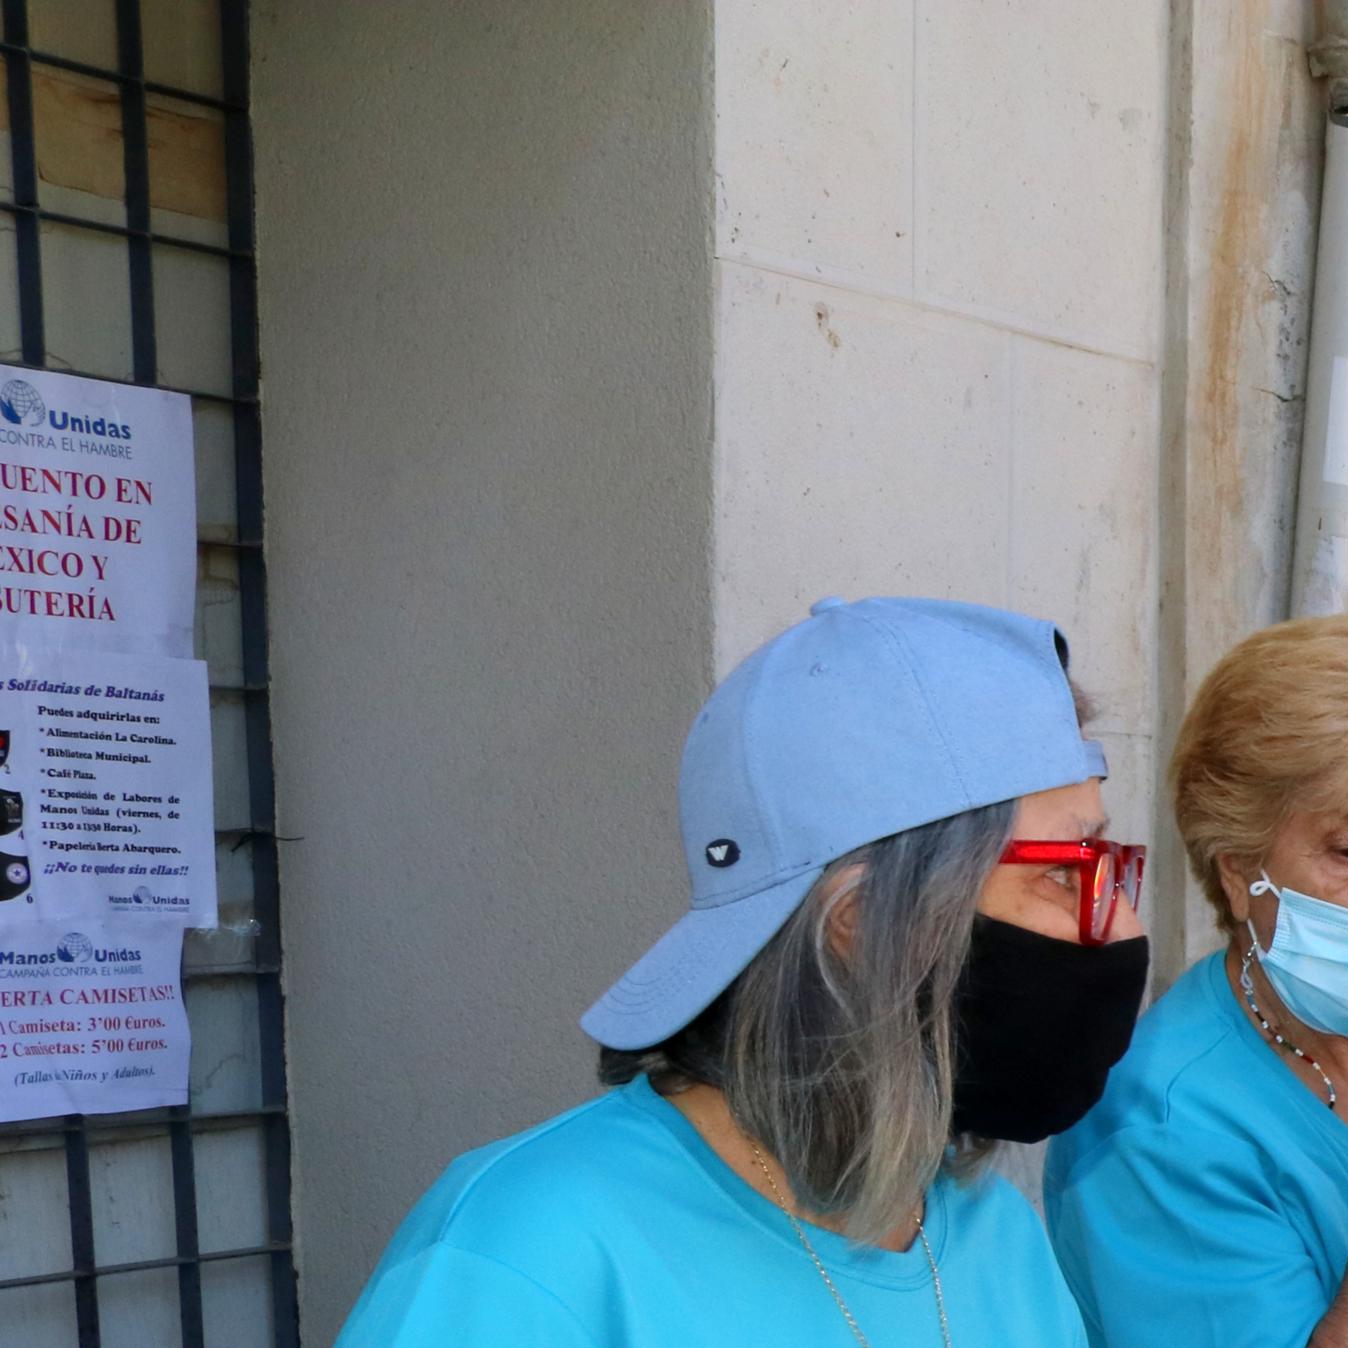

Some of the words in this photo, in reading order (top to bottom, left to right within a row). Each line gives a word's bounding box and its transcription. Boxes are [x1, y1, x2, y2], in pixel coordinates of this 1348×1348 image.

[49, 410, 132, 440] Unidas
[62, 437, 75, 452] EL
[80, 443, 133, 460] HAMBRE
[115, 477, 153, 506] EN
[103, 516, 143, 545] DE
[92, 555, 109, 581] Y
[7, 678, 80, 699] Solidarias
[84, 685, 102, 699] de
[105, 686, 165, 703] Baltanás
[37, 706, 74, 719] Puedes
[76, 710, 142, 726] adquirirlas
[115, 732, 127, 743] La
[103, 792, 116, 802] de
[122, 792, 162, 804] Labores
[168, 795, 180, 805] de
[40, 804, 78, 815] Manos
[167, 810, 180, 820] de
[128, 863, 147, 875] sin
[152, 896, 190, 905] Unidas
[0, 952, 56, 965] Manos
[95, 949, 141, 963] Unidas
[53, 966, 98, 977] CONTRA
[101, 966, 111, 977] EL
[113, 965, 144, 976] HAMBRE
